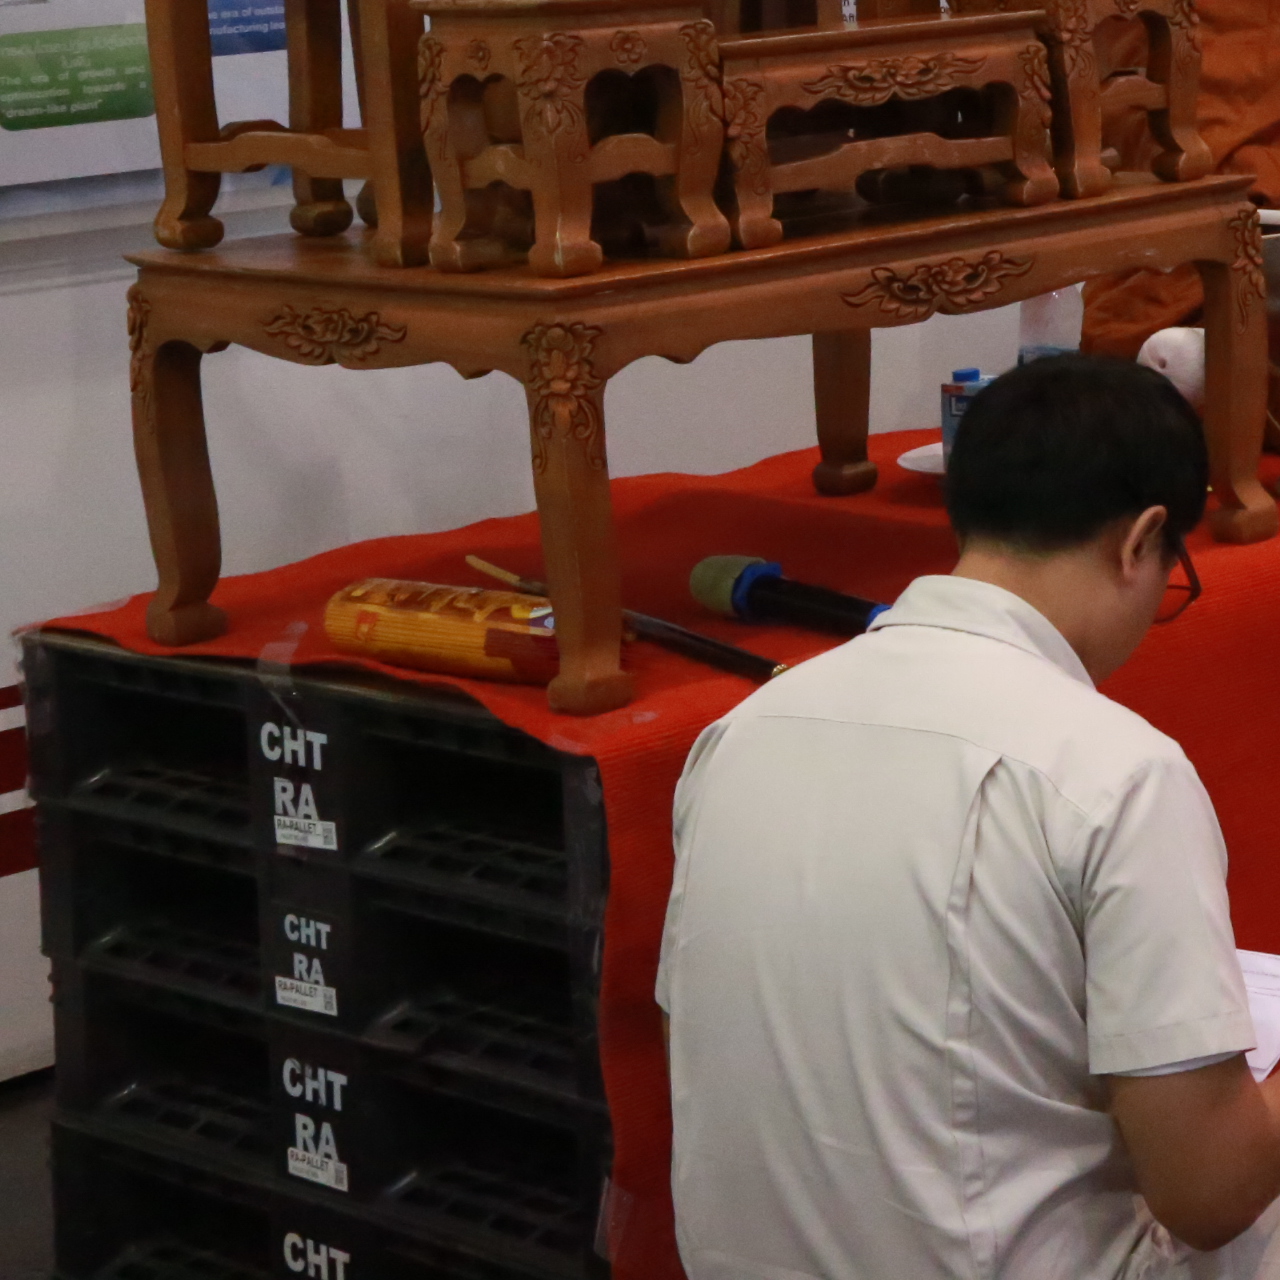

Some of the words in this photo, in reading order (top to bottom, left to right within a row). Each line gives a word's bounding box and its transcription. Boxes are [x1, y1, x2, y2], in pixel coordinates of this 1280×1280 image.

[261, 722, 328, 770] CHT
[274, 777, 320, 821] RA
[284, 913, 331, 950] CHT
[293, 952, 325, 987] RA
[283, 1057, 348, 1111] CHT
[295, 1113, 339, 1163] RA
[283, 1232, 350, 1280] CHT
